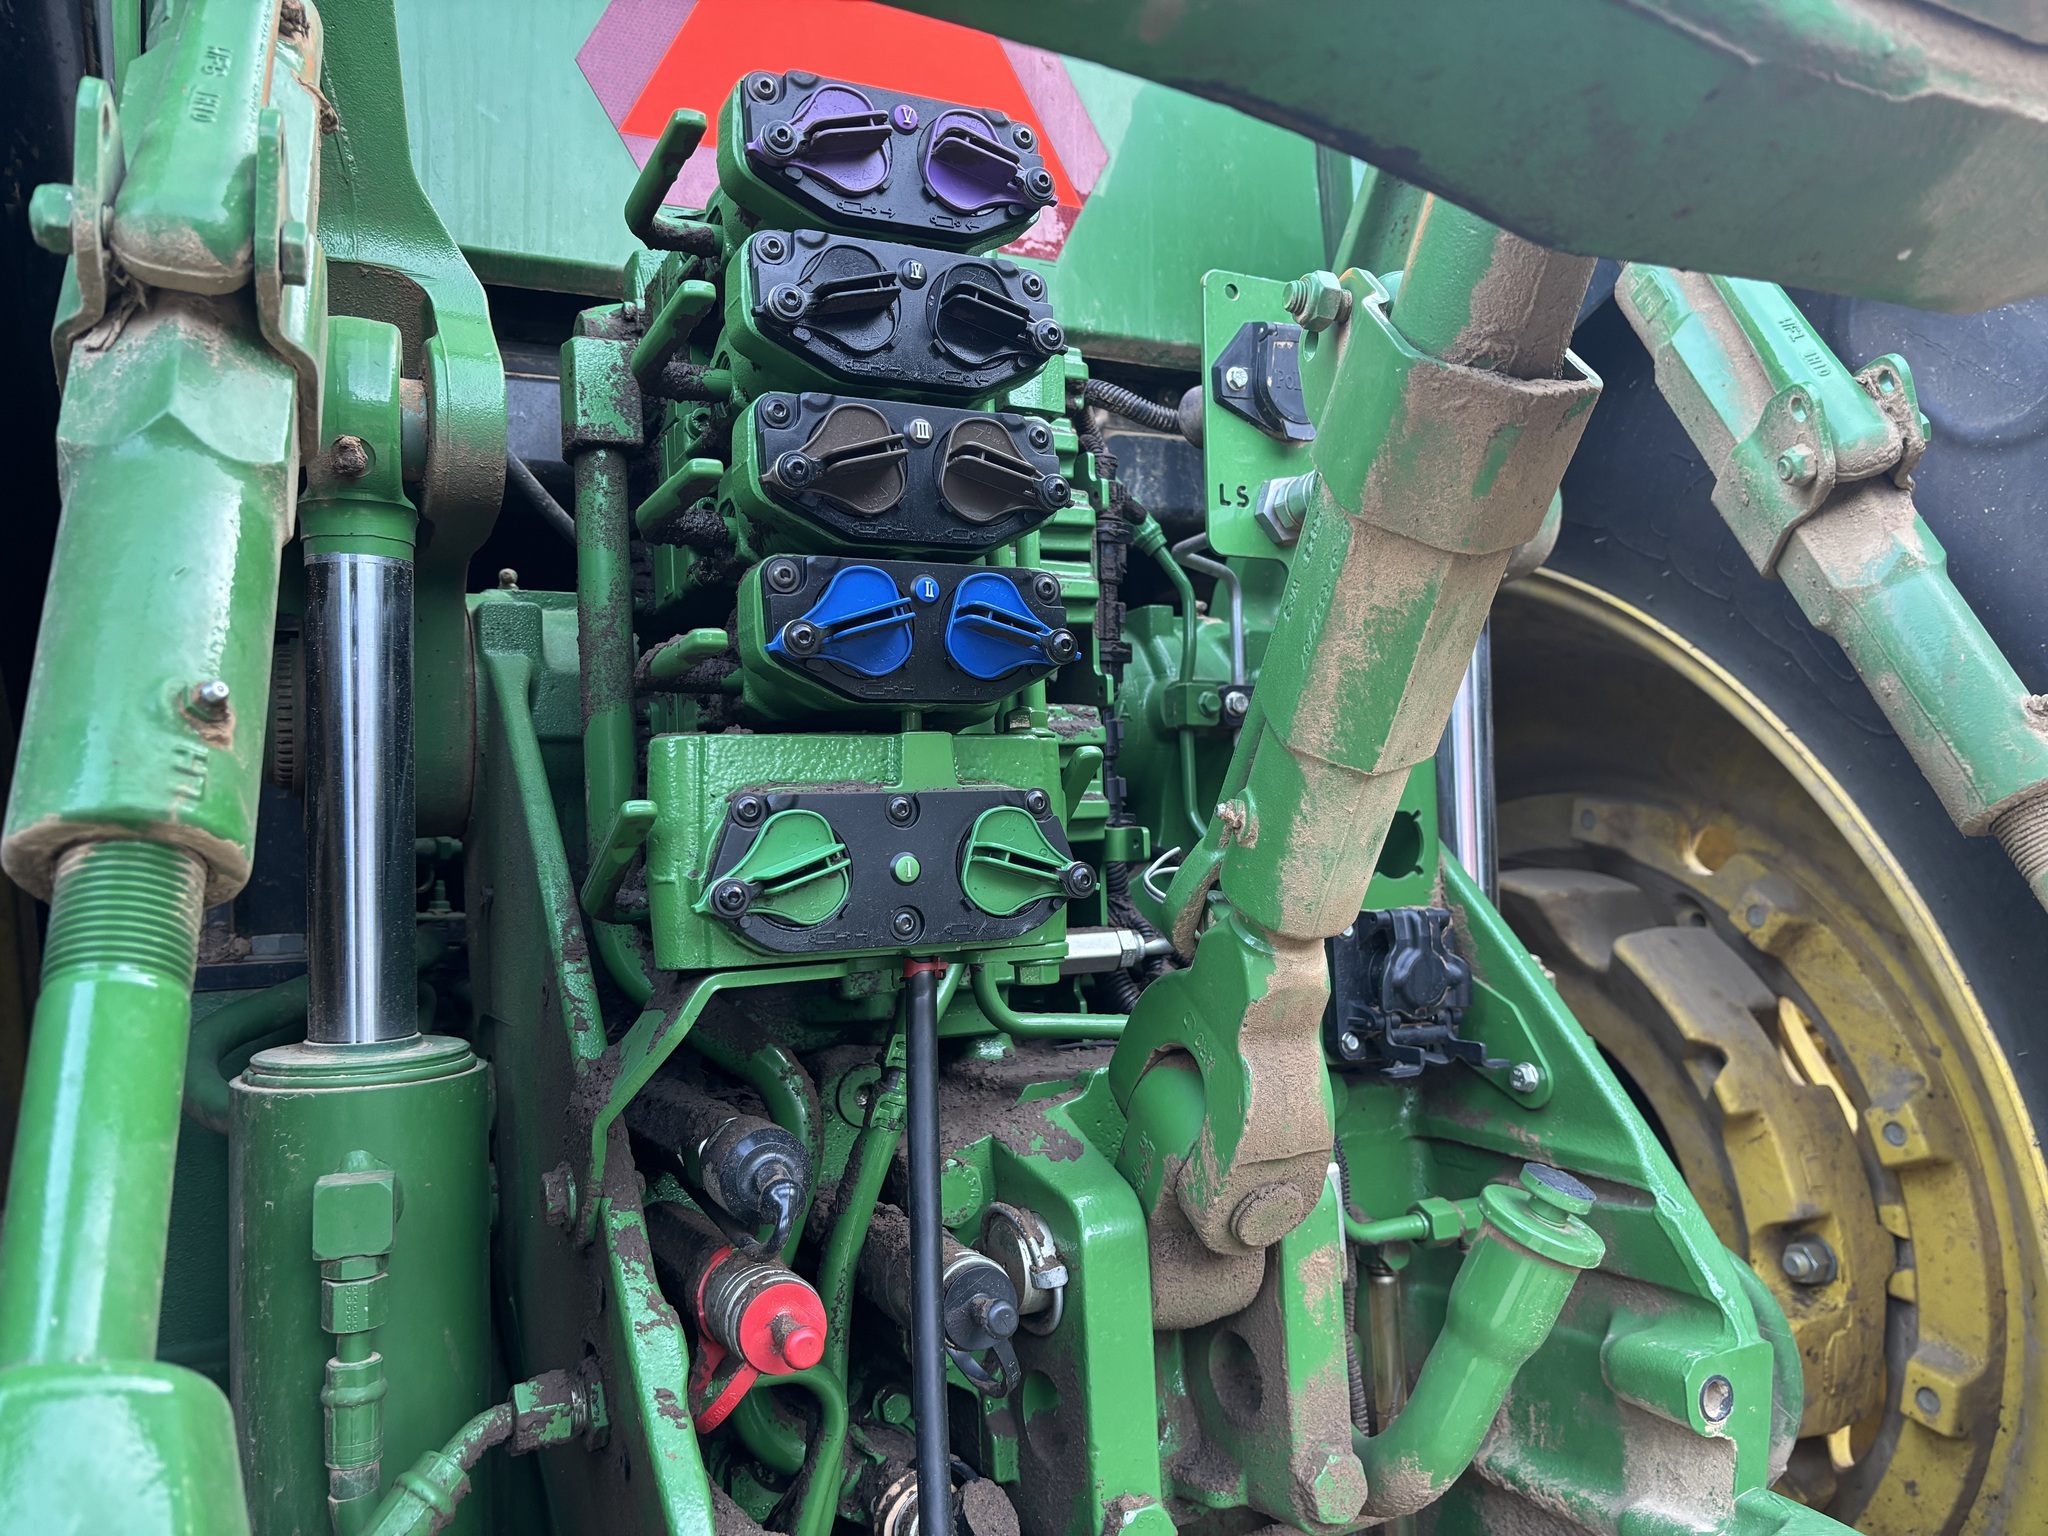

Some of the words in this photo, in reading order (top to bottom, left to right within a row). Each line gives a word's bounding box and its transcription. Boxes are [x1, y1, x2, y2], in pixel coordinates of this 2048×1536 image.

[902, 106, 914, 125] V
[910, 262, 922, 279] IV
[915, 421, 930, 439] III
[1219, 483, 1250, 508] LS
[924, 581, 935, 598] II
